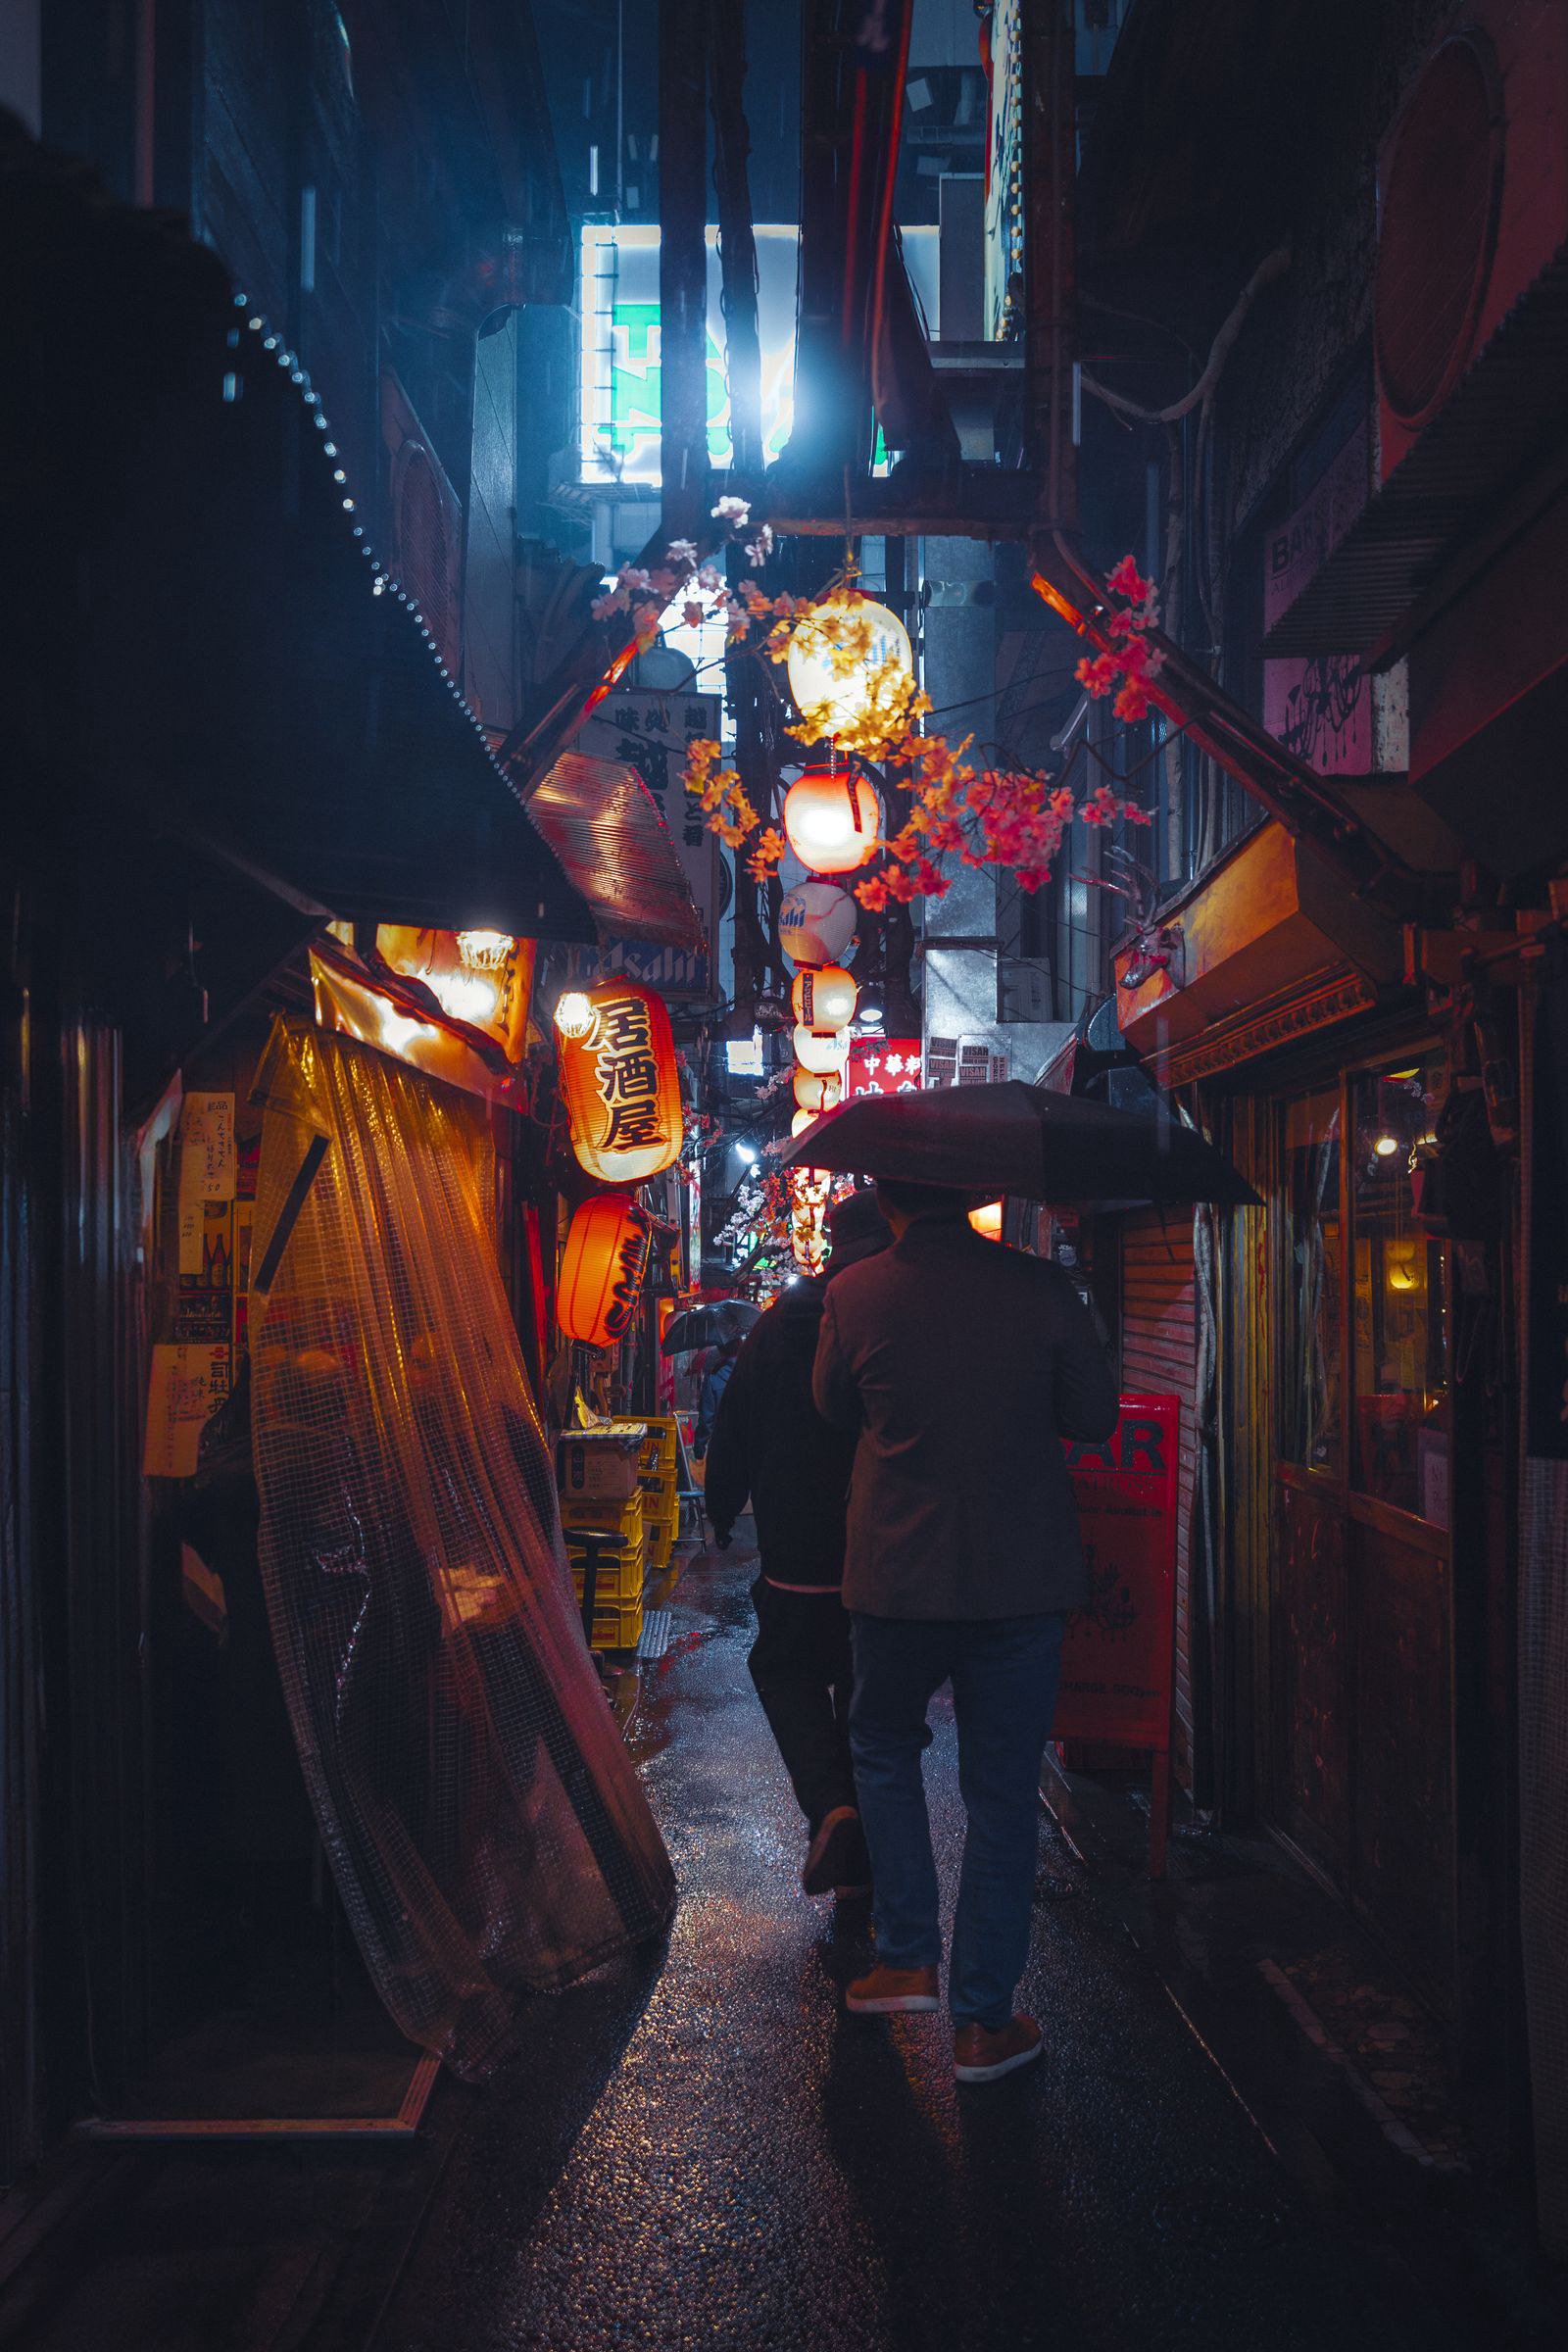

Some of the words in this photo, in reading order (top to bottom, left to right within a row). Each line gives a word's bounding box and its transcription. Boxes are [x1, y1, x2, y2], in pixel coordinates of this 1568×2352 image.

[594, 941, 697, 982] Asahi
[962, 1046, 989, 1055] VISAH
[585, 998, 667, 1153] 居酒屋
[960, 1067, 986, 1077] VISAH
[1064, 1419, 1167, 1472] AR
[1060, 1681, 1106, 1694] HARGE
